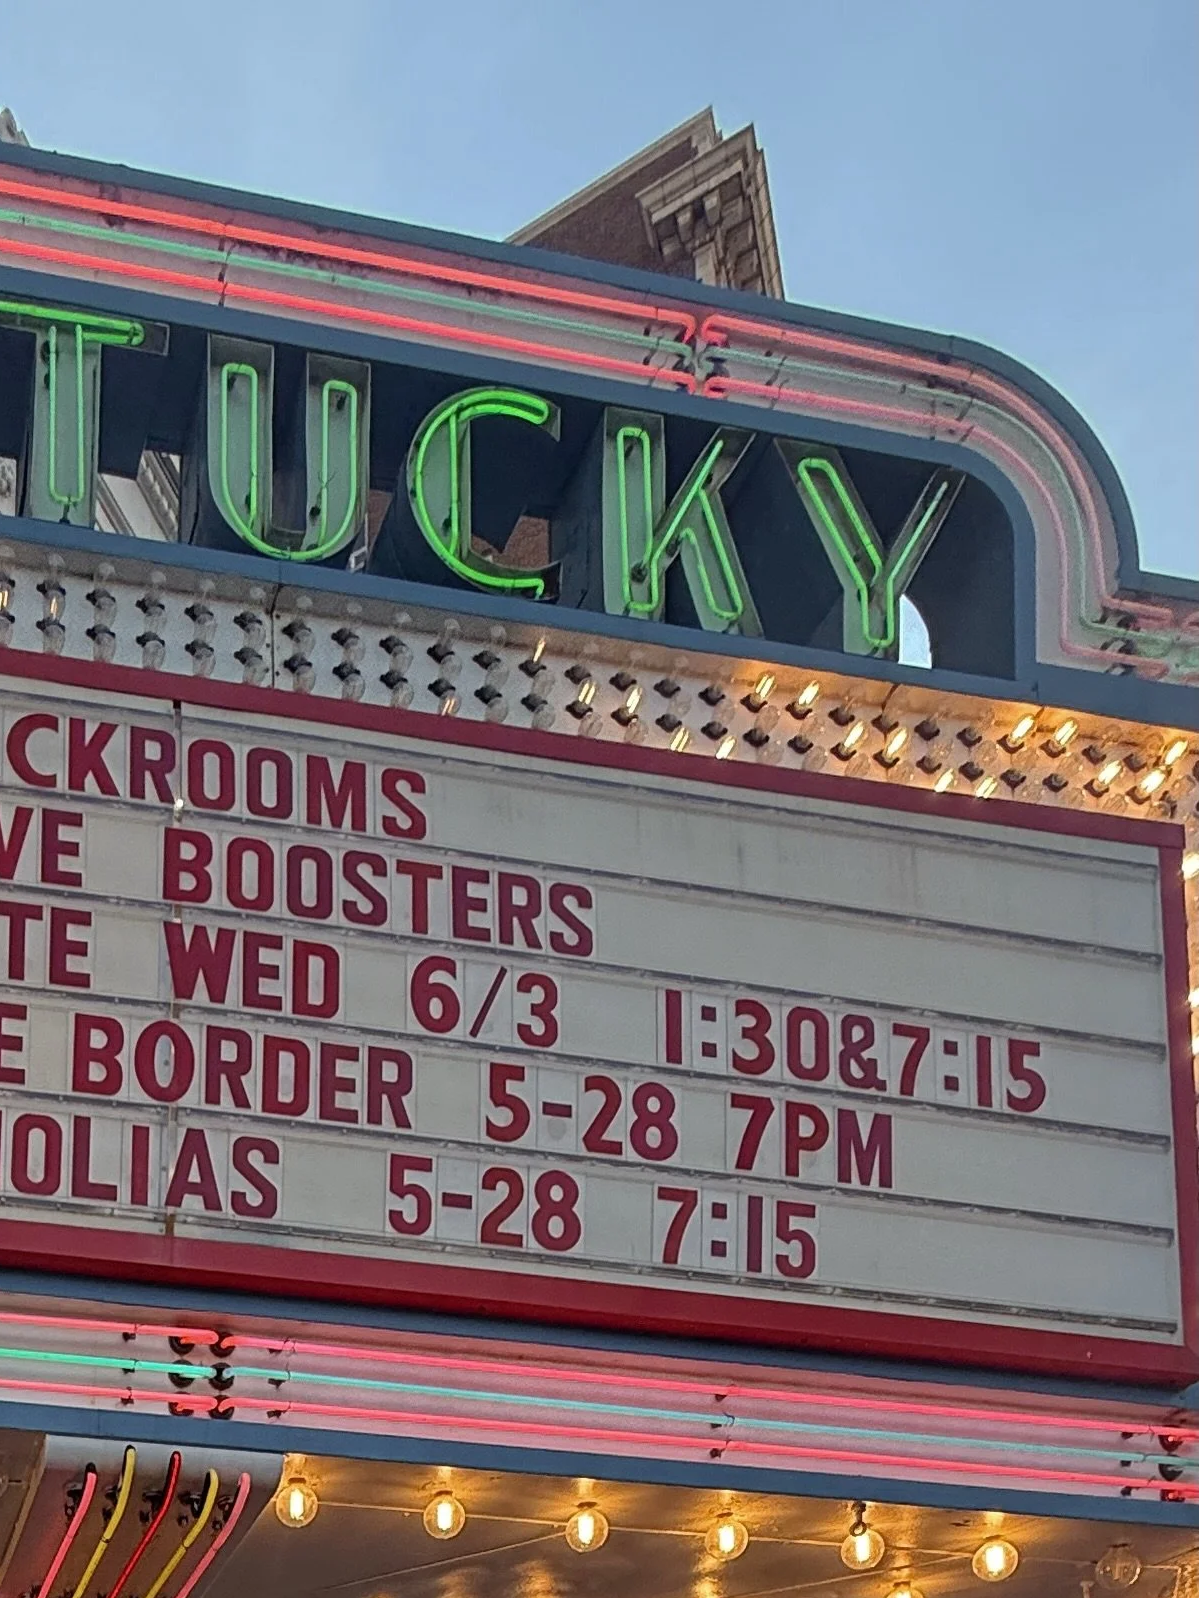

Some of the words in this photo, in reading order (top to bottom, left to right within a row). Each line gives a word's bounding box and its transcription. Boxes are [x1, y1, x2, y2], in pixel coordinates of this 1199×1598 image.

[163, 827, 593, 957] BOOSTERS
[165, 922, 340, 1019] WED
[410, 956, 559, 1047] 6/3
[665, 989, 1047, 1113] 1:30&7:15
[73, 1012, 413, 1129] BORDER
[486, 1062, 678, 1161] 5-28
[731, 1094, 893, 1188] 7PM
[389, 1153, 581, 1253] 5-28
[656, 1186, 818, 1278] 7:15
